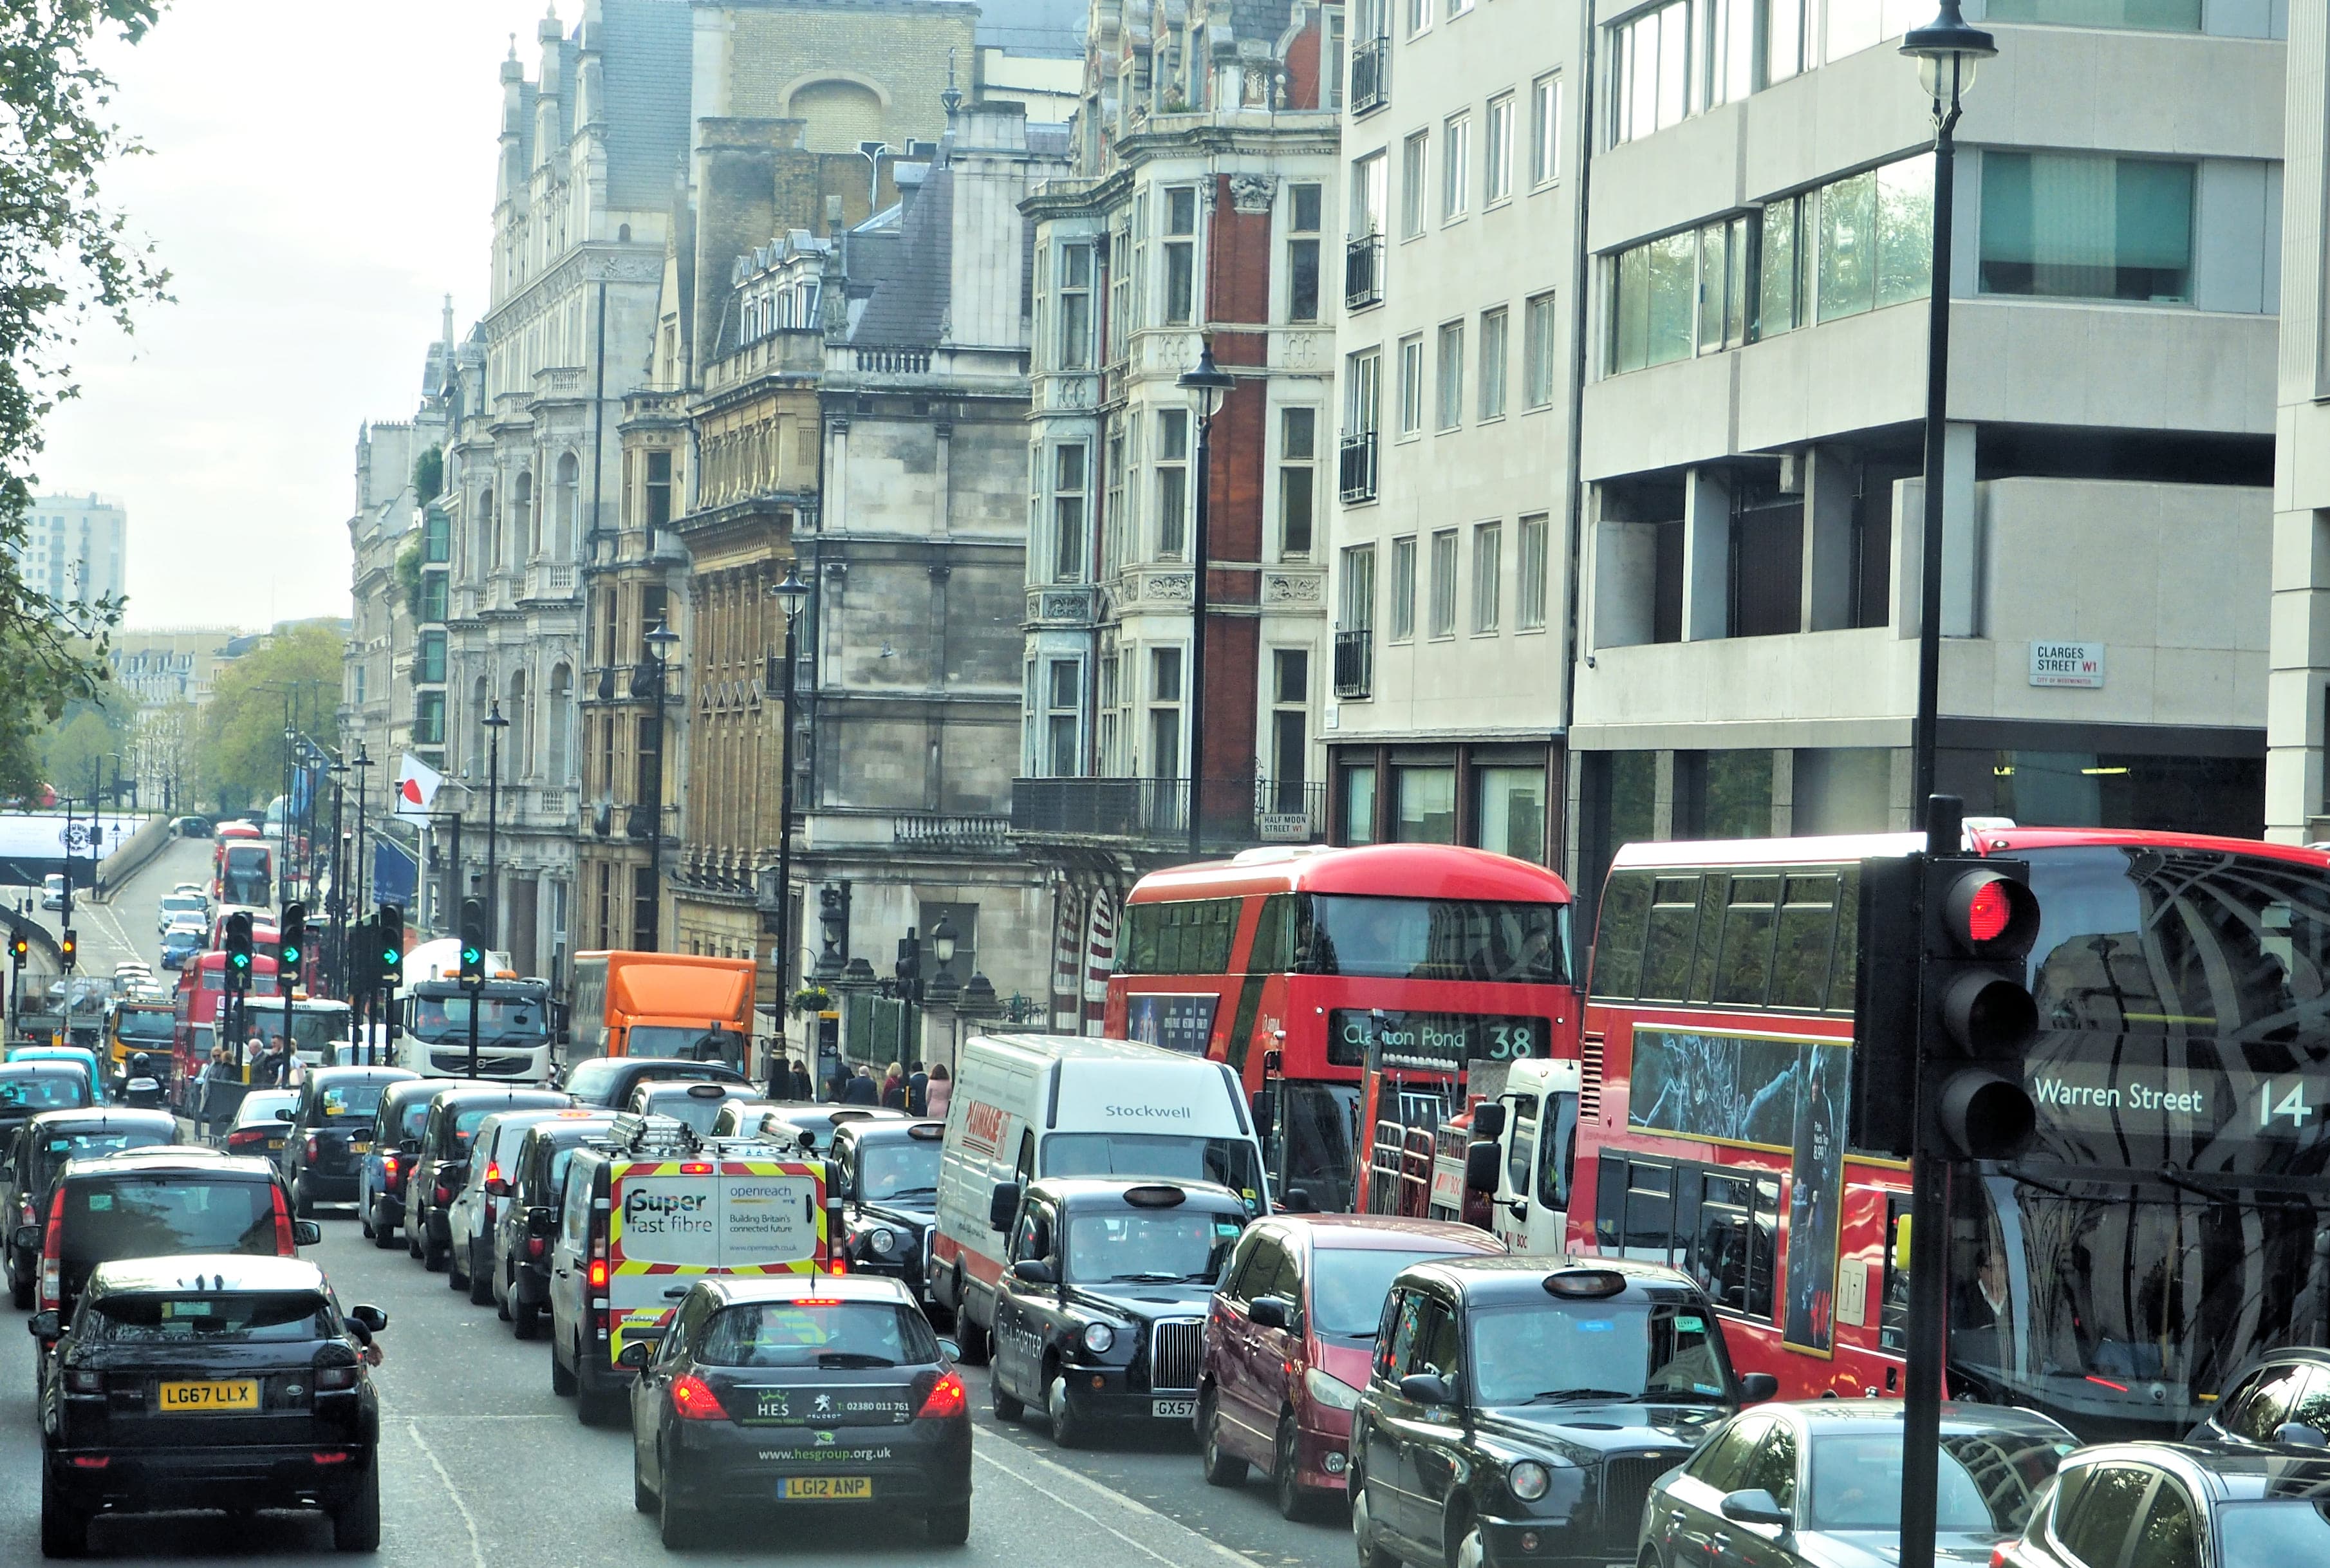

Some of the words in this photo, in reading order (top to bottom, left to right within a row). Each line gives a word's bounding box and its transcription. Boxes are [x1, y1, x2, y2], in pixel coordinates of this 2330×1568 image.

[2038, 646, 2084, 659] CLARGES
[2038, 659, 2076, 671] STREET
[2082, 661, 2096, 672] W1
[1422, 1029, 1465, 1047] Pond
[1489, 1027, 1531, 1059] 38
[2035, 1077, 2120, 1107] Warren
[2129, 1083, 2203, 1113] Street
[2260, 1079, 2313, 1127] 14
[1105, 1105, 1191, 1118] Stockwell
[731, 1186, 791, 1197] openreach
[1451, 1175, 1461, 1195] BOC
[631, 1189, 707, 1216] Super
[632, 1216, 665, 1233] fast
[672, 1216, 712, 1233] fibre
[730, 1215, 760, 1224] Building
[762, 1215, 791, 1223] Britain's
[1517, 1233, 1527, 1249] BOC
[168, 1388, 210, 1403] LG67
[216, 1386, 248, 1402] LLX
[758, 1404, 789, 1416] H.E.S
[838, 1402, 844, 1411] T:
[1159, 1402, 1194, 1415] GX57
[759, 1448, 891, 1461] www.hesgroup.org.uk
[792, 1480, 828, 1495] LG12
[834, 1480, 864, 1495] ANP
